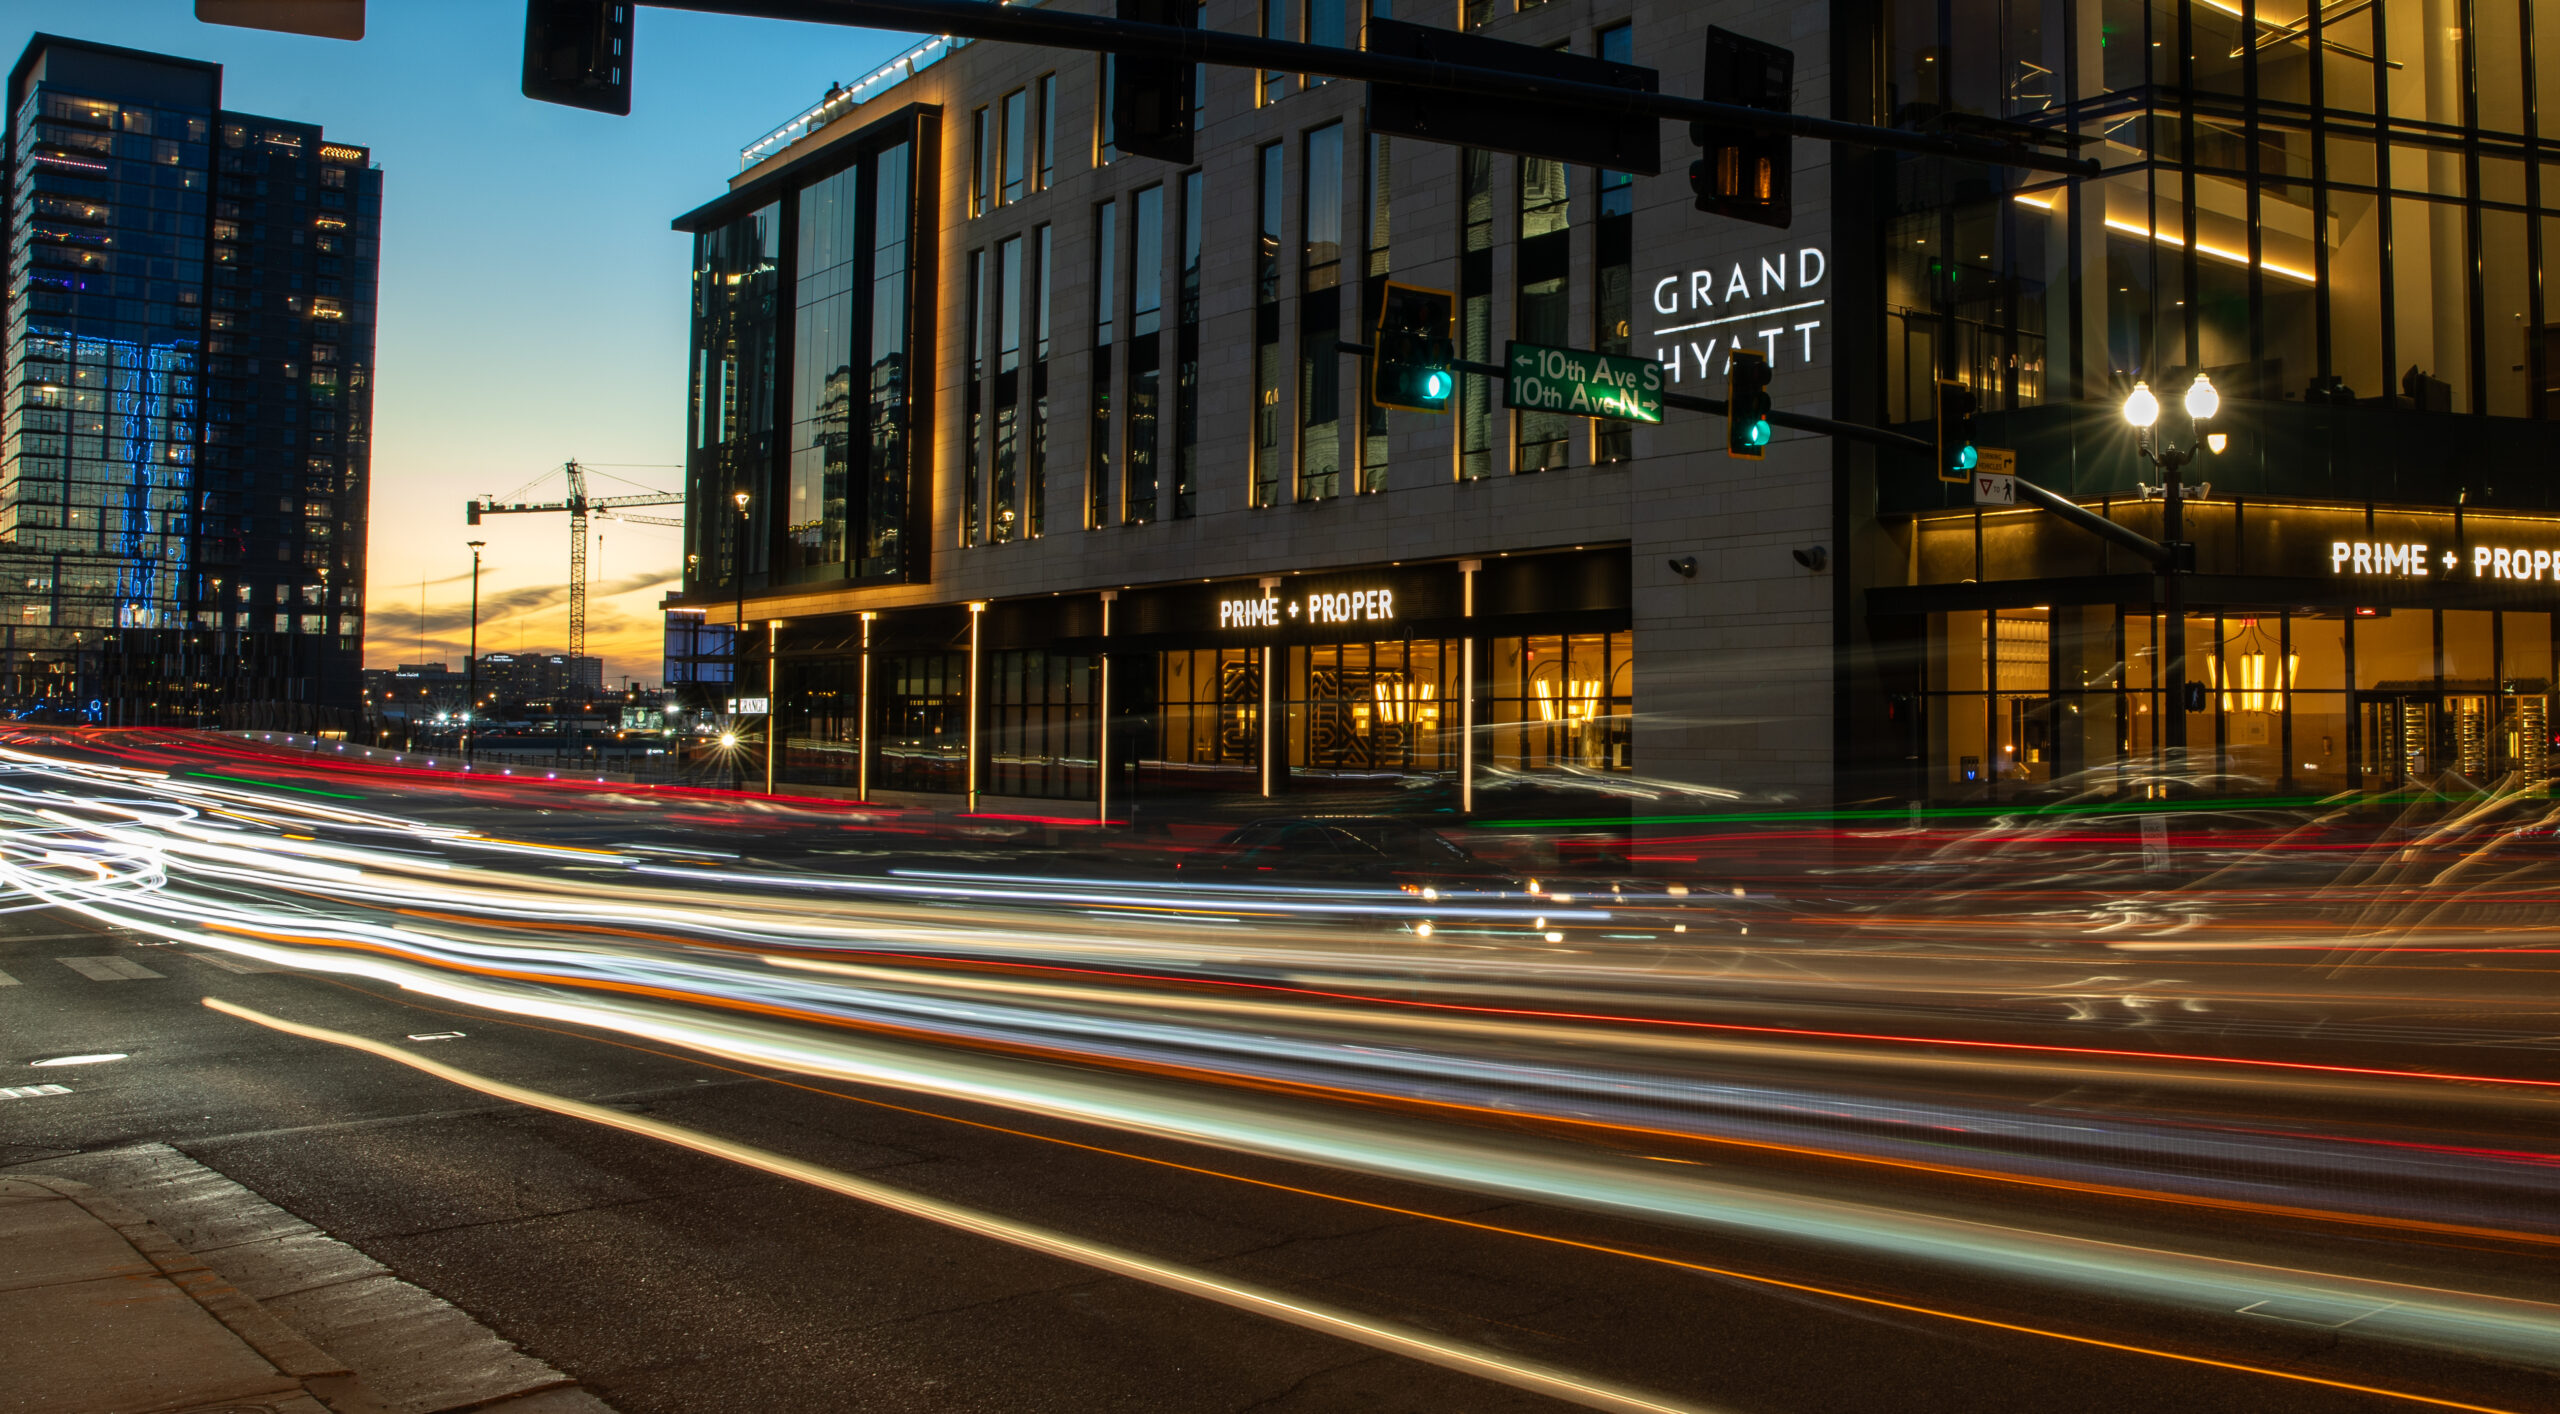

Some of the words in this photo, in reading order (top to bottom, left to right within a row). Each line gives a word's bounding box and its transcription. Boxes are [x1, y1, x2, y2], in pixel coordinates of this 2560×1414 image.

[1654, 248, 1825, 314] GRAND
[1538, 349, 1586, 382] 10th
[1592, 357, 1636, 388] Ave
[1643, 363, 1660, 391] S
[1513, 375, 1562, 408] 10th
[1568, 383, 1614, 414] Ave
[1619, 387, 1640, 418] N
[1993, 485, 2001, 494] TO
[2332, 542, 2429, 576] PRIME
[2442, 551, 2458, 569] +
[1221, 597, 1280, 628] PRIME
[1288, 601, 1300, 618] +
[1309, 589, 1394, 623] PROPER
